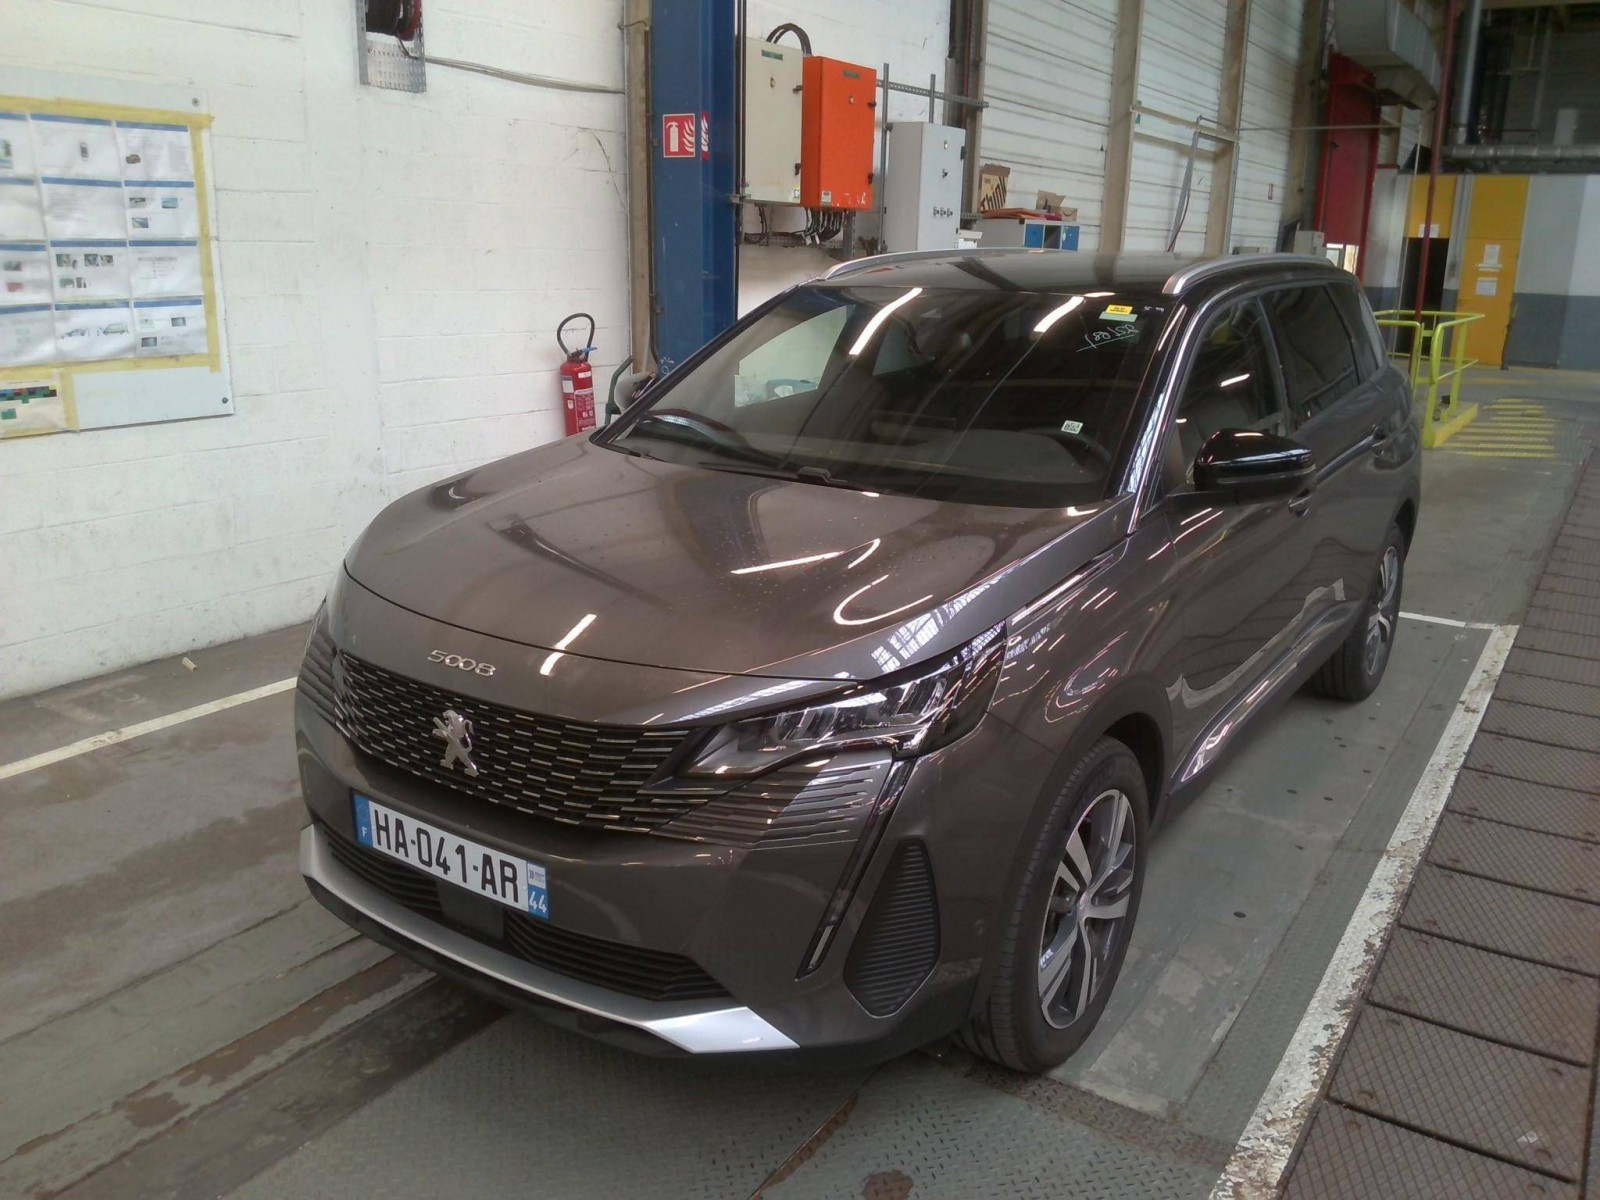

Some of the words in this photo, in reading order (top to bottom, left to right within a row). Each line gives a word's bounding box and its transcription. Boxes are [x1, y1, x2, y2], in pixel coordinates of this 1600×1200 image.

[427, 650, 496, 677] 5008
[361, 826, 368, 838] F
[374, 809, 519, 903] HA-041-AR
[529, 891, 547, 914] 44
